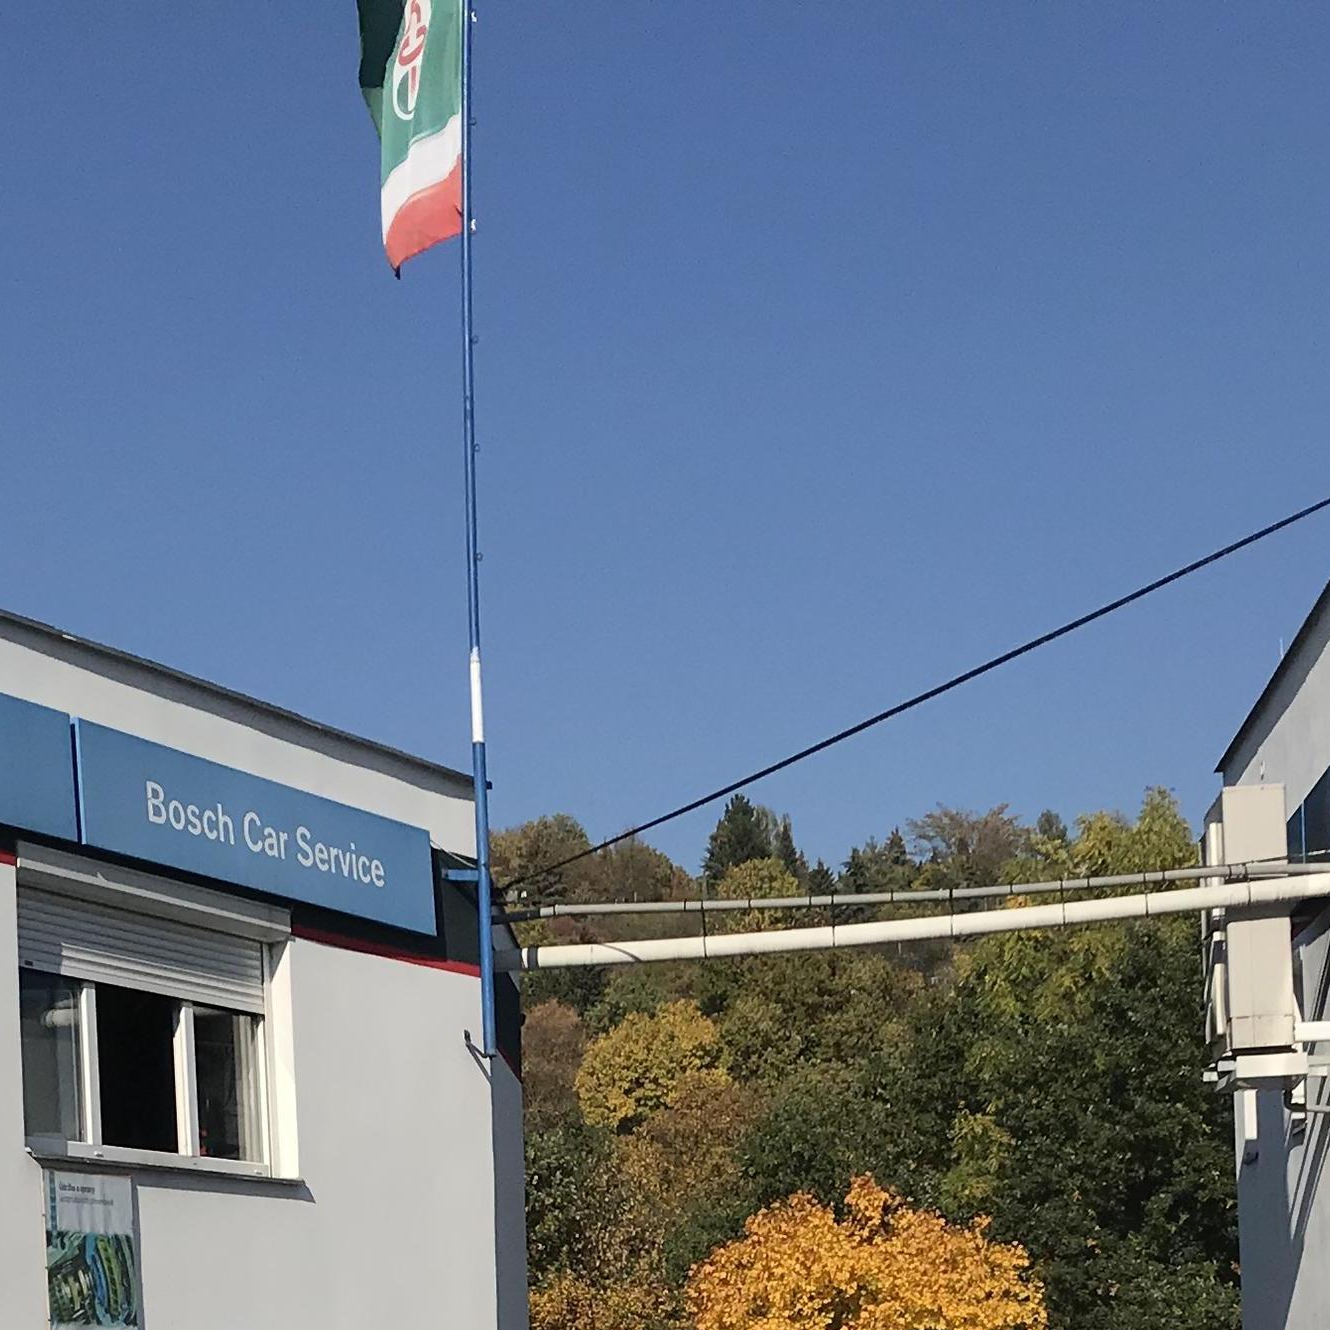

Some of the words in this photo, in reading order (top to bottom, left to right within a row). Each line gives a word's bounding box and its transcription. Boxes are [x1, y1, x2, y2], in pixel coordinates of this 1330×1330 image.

[145, 780, 235, 845] Bosch
[243, 811, 288, 860] Car
[296, 825, 385, 888] Service
